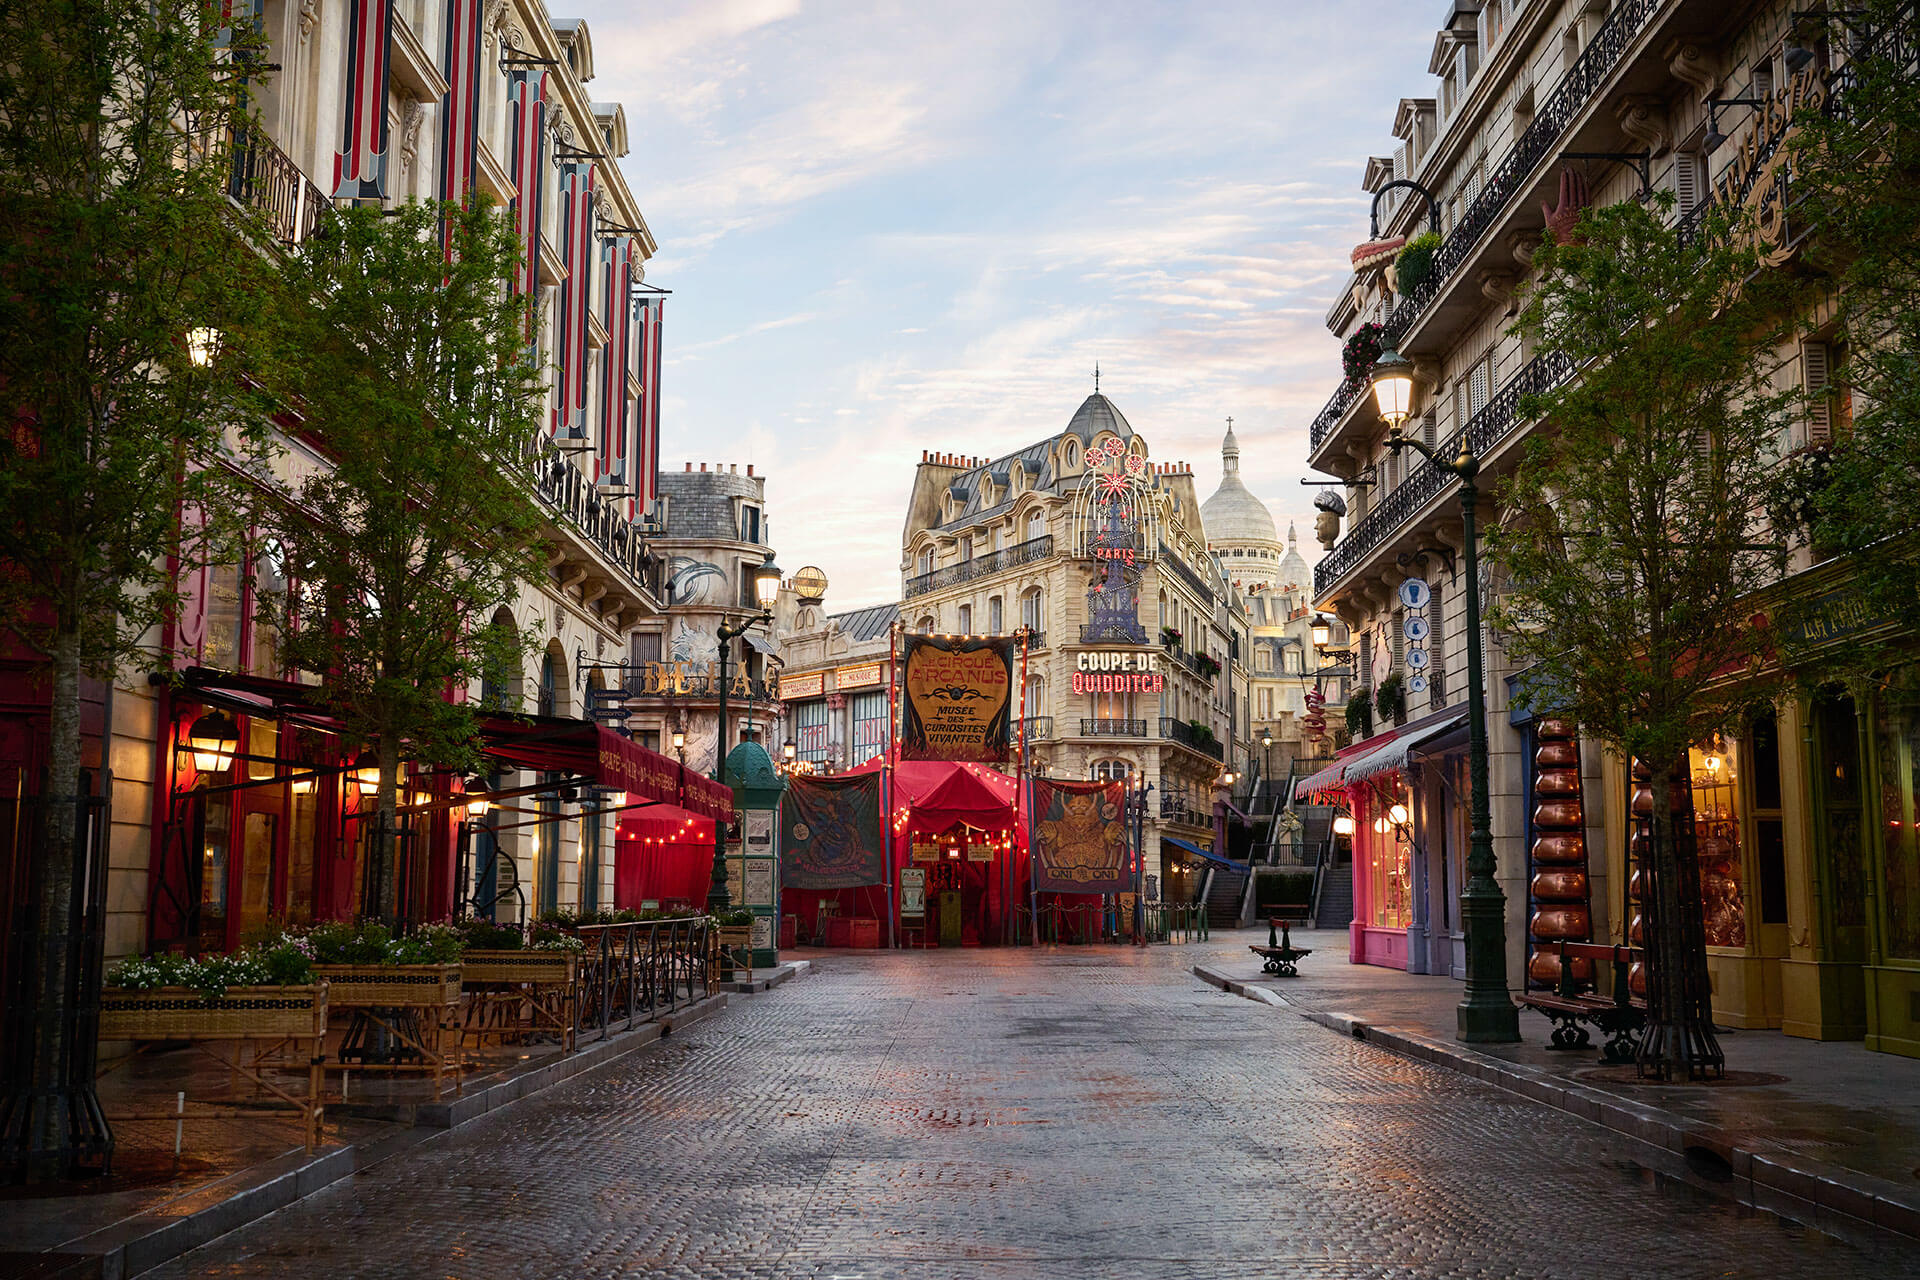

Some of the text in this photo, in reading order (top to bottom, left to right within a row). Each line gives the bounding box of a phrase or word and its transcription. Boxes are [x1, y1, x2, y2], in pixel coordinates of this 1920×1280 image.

[1096, 547, 1135, 560] PARIS
[937, 656, 994, 669] CIRQUE
[1077, 651, 1157, 671] COUPE DE
[640, 658, 693, 697] DE
[911, 669, 1006, 684] ARCANUS
[1072, 672, 1163, 696] QUIDDITCH
[929, 734, 982, 745] VIVANTES
[1051, 871, 1072, 879] ONI
[1092, 871, 1114, 879] ONI
